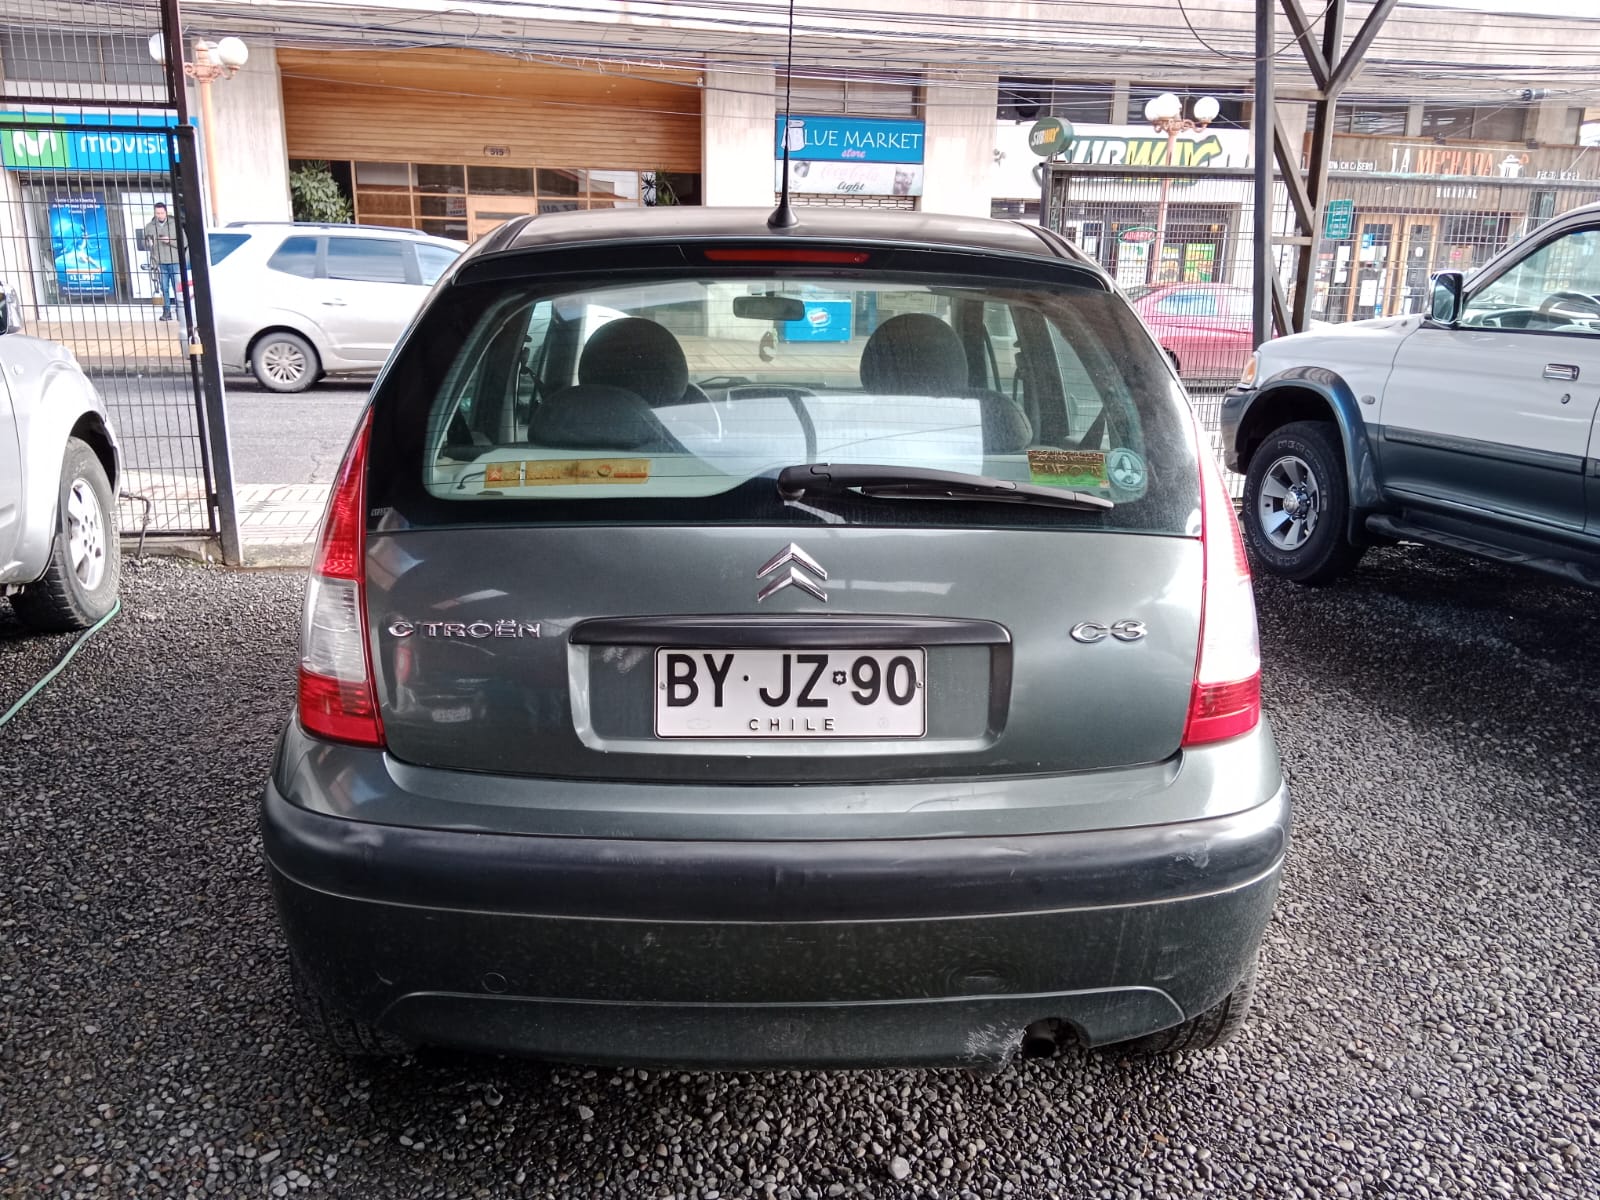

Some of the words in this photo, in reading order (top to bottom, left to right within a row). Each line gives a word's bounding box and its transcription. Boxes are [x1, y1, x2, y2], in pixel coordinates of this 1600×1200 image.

[80, 135, 179, 155] movista
[843, 130, 923, 149] MARKET
[1031, 127, 1060, 146] SUBWAY
[841, 148, 867, 159] store
[1390, 148, 1411, 174] LA
[836, 181, 865, 193] light
[1070, 620, 1148, 643] C3
[749, 718, 836, 732] CHILE
